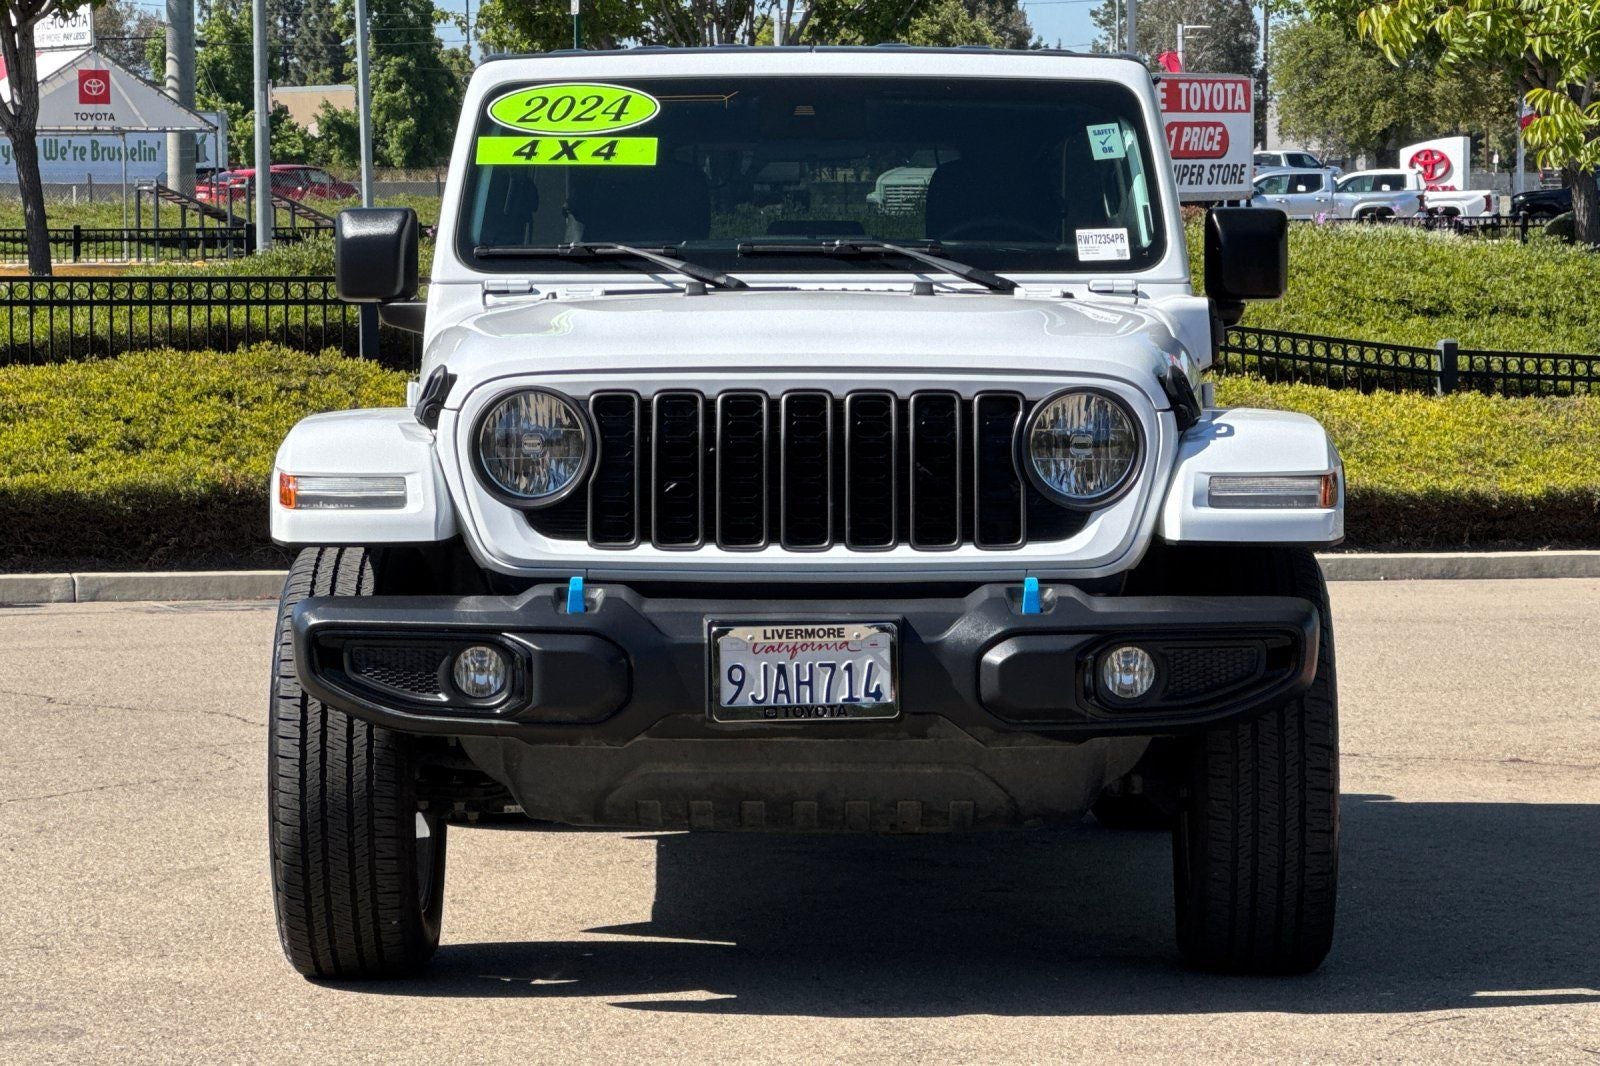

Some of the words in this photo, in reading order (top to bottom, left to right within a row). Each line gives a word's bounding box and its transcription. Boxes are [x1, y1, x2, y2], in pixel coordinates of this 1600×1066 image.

[1178, 82, 1246, 111] TOYOTA
[74, 112, 116, 122] TOYOTA
[516, 95, 633, 123] 2024
[1181, 126, 1224, 151] PRICE
[43, 138, 87, 162] We're
[90, 140, 162, 162] Brusselin'
[1207, 163, 1247, 185] STORE
[1077, 233, 1126, 246] RW172354PR
[763, 627, 846, 641] LIVERMORE
[751, 641, 861, 660] California
[727, 661, 883, 705] 9JAH714
[782, 704, 848, 718] TOYOTA
